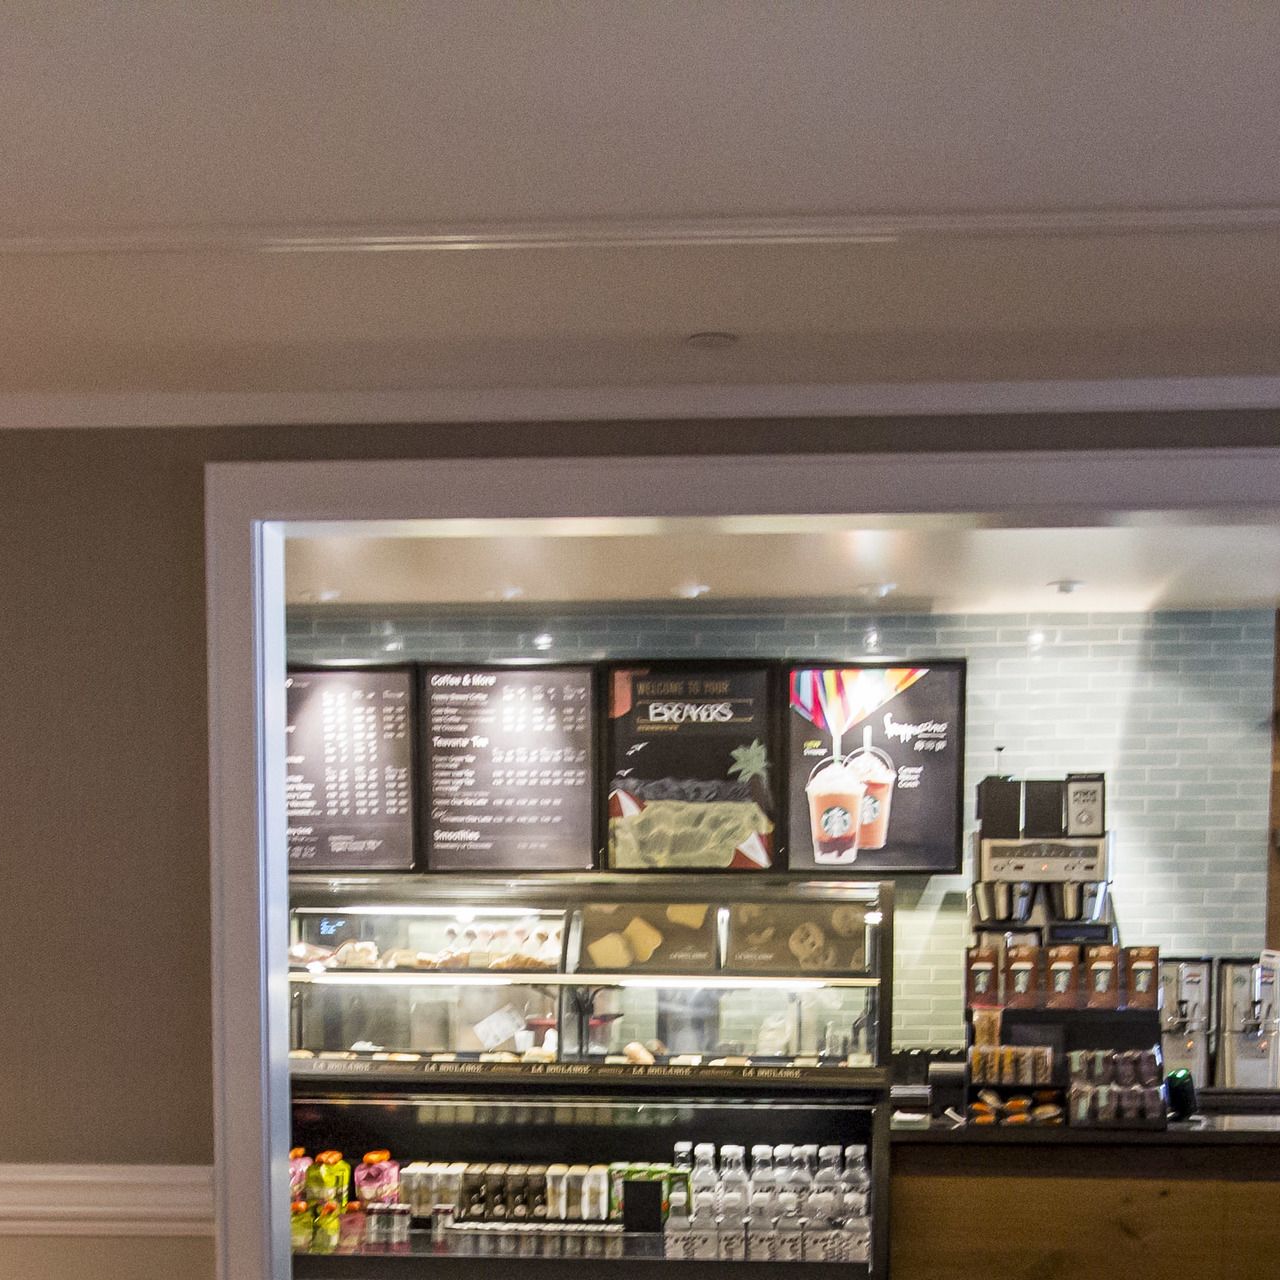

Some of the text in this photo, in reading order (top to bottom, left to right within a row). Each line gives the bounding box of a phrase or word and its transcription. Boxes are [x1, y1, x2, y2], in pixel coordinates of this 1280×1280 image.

[431, 674, 497, 687] Coffee & More
[637, 680, 684, 695] WELCOME
[530, 1064, 544, 1074] LA
[632, 1066, 645, 1075] LA
